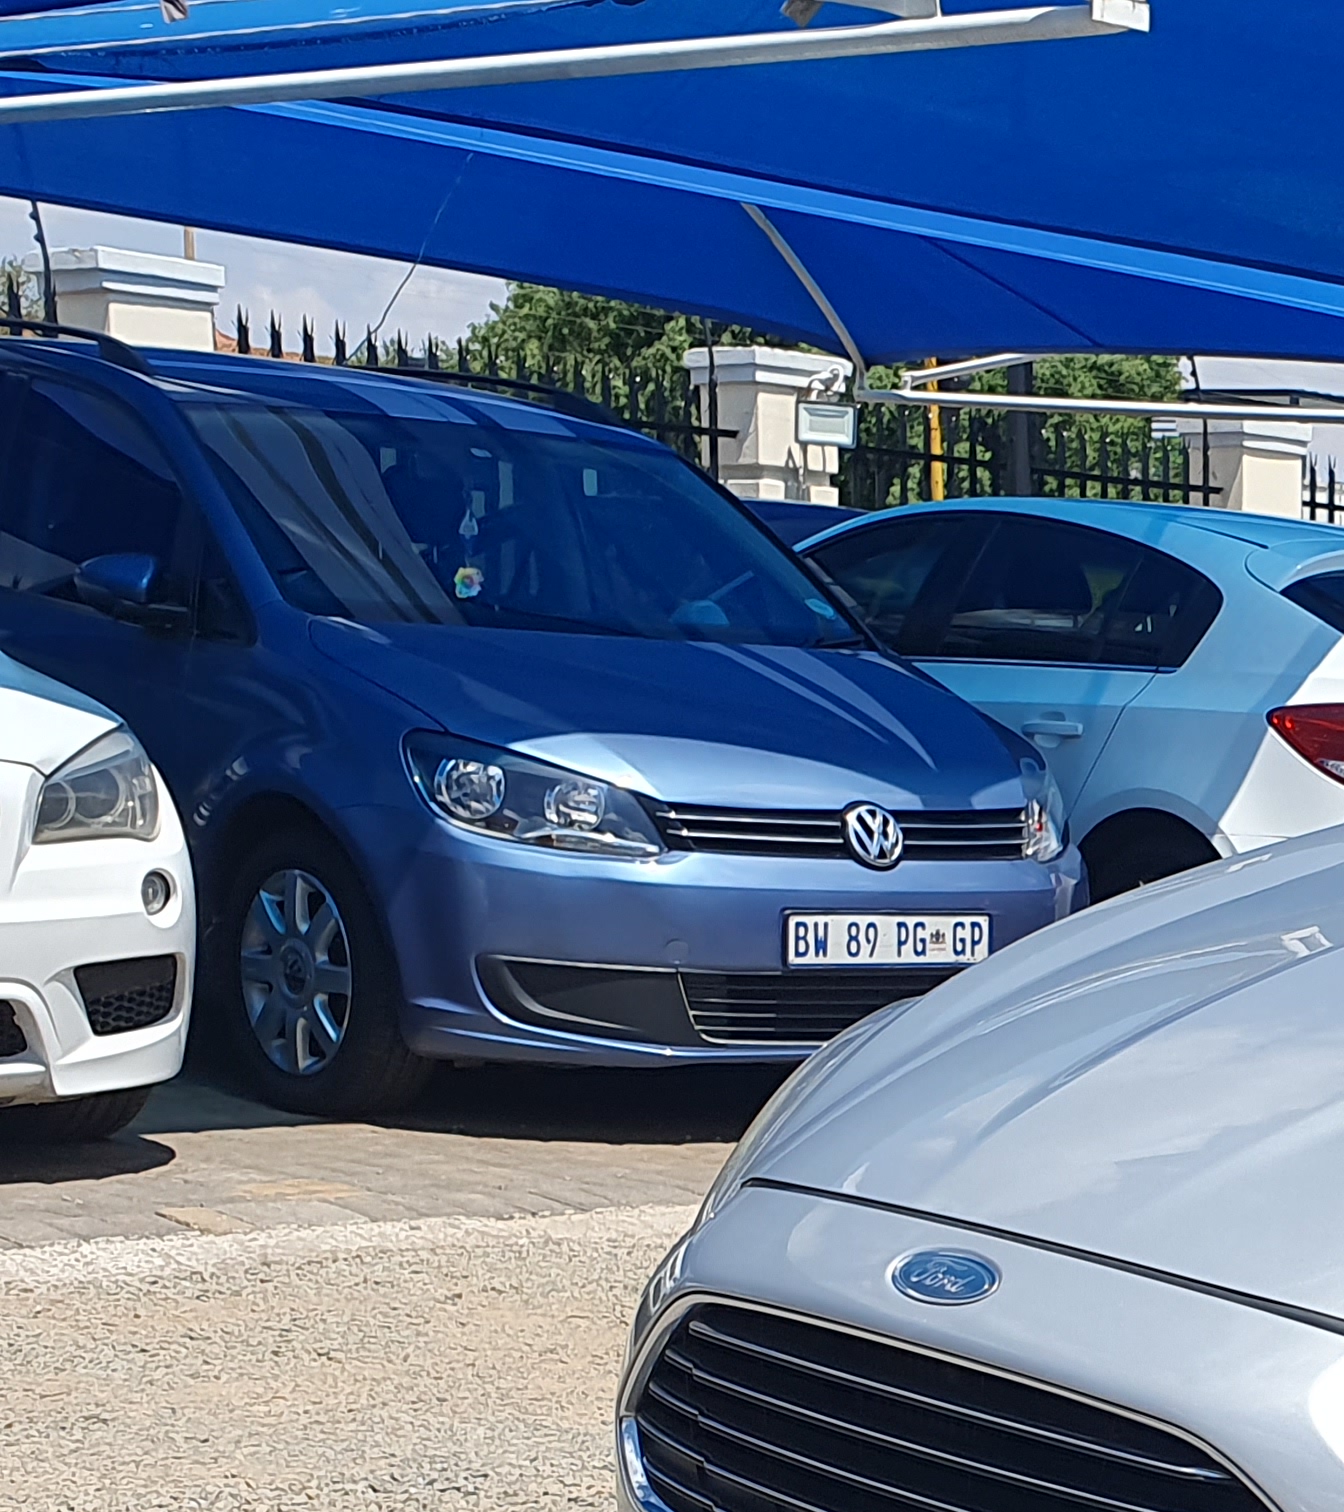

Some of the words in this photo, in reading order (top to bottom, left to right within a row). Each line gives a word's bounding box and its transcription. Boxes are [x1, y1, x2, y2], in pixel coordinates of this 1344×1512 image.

[793, 921, 829, 958] BW
[846, 921, 879, 958] 89
[896, 921, 927, 957] PG
[952, 921, 983, 957] GP
[909, 1258, 976, 1293] Ford
